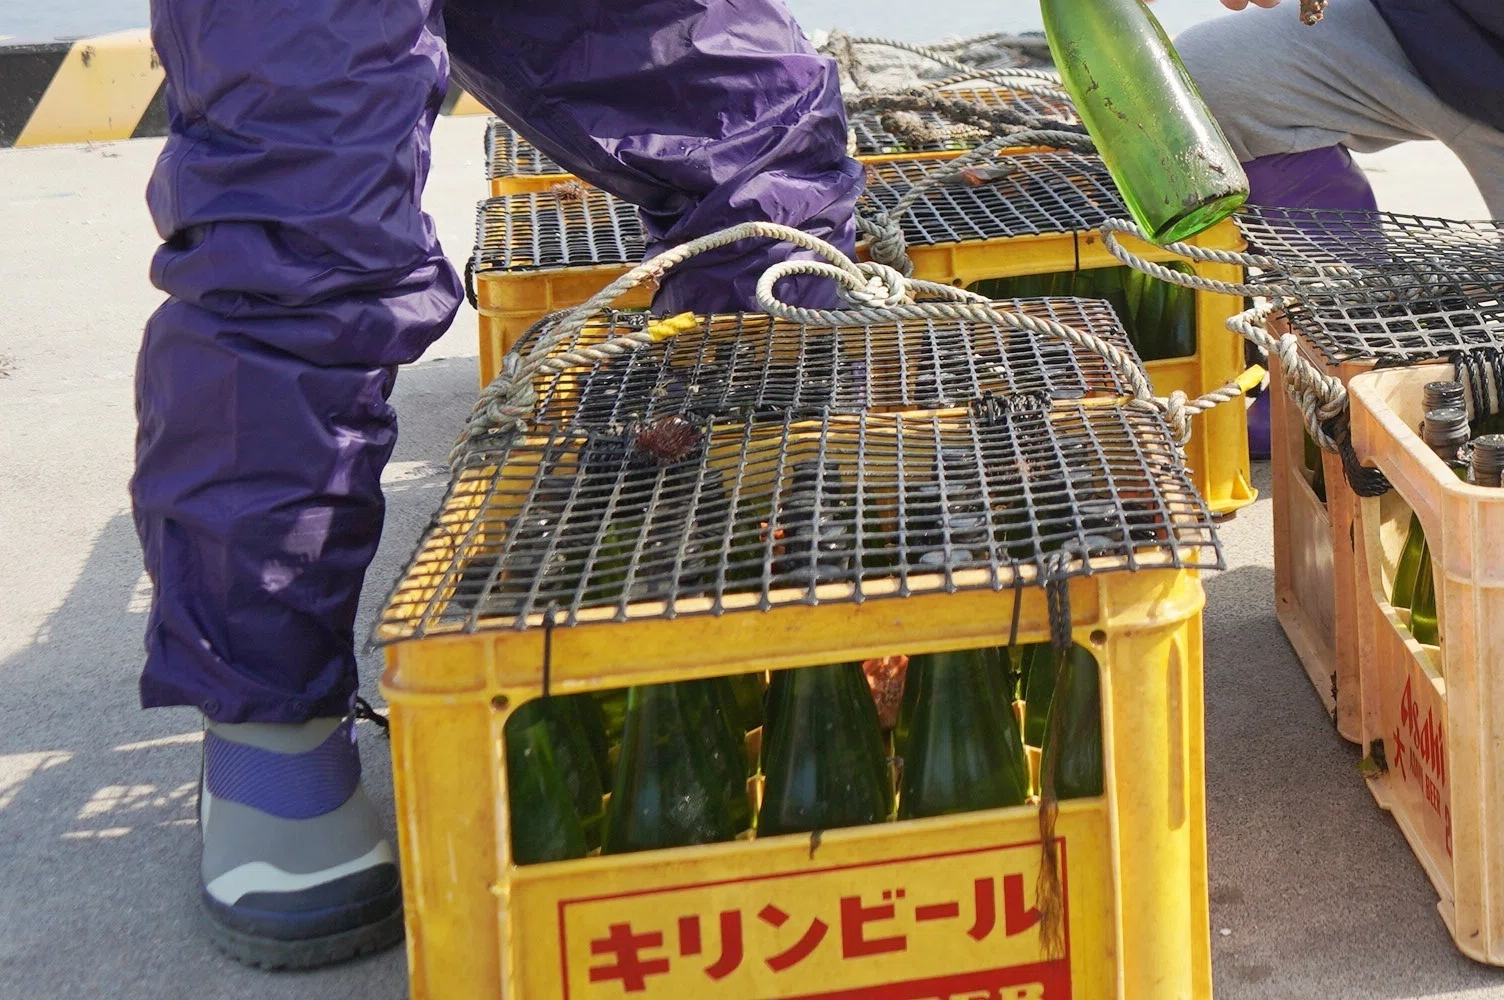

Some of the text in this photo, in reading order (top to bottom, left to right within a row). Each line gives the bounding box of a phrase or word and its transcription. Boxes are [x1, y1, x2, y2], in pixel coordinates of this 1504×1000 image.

[1393, 727, 1406, 783] 大
[1401, 673, 1446, 788] Asahi
[1425, 774, 1442, 818] BEER
[588, 873, 1042, 992] キリンビール
